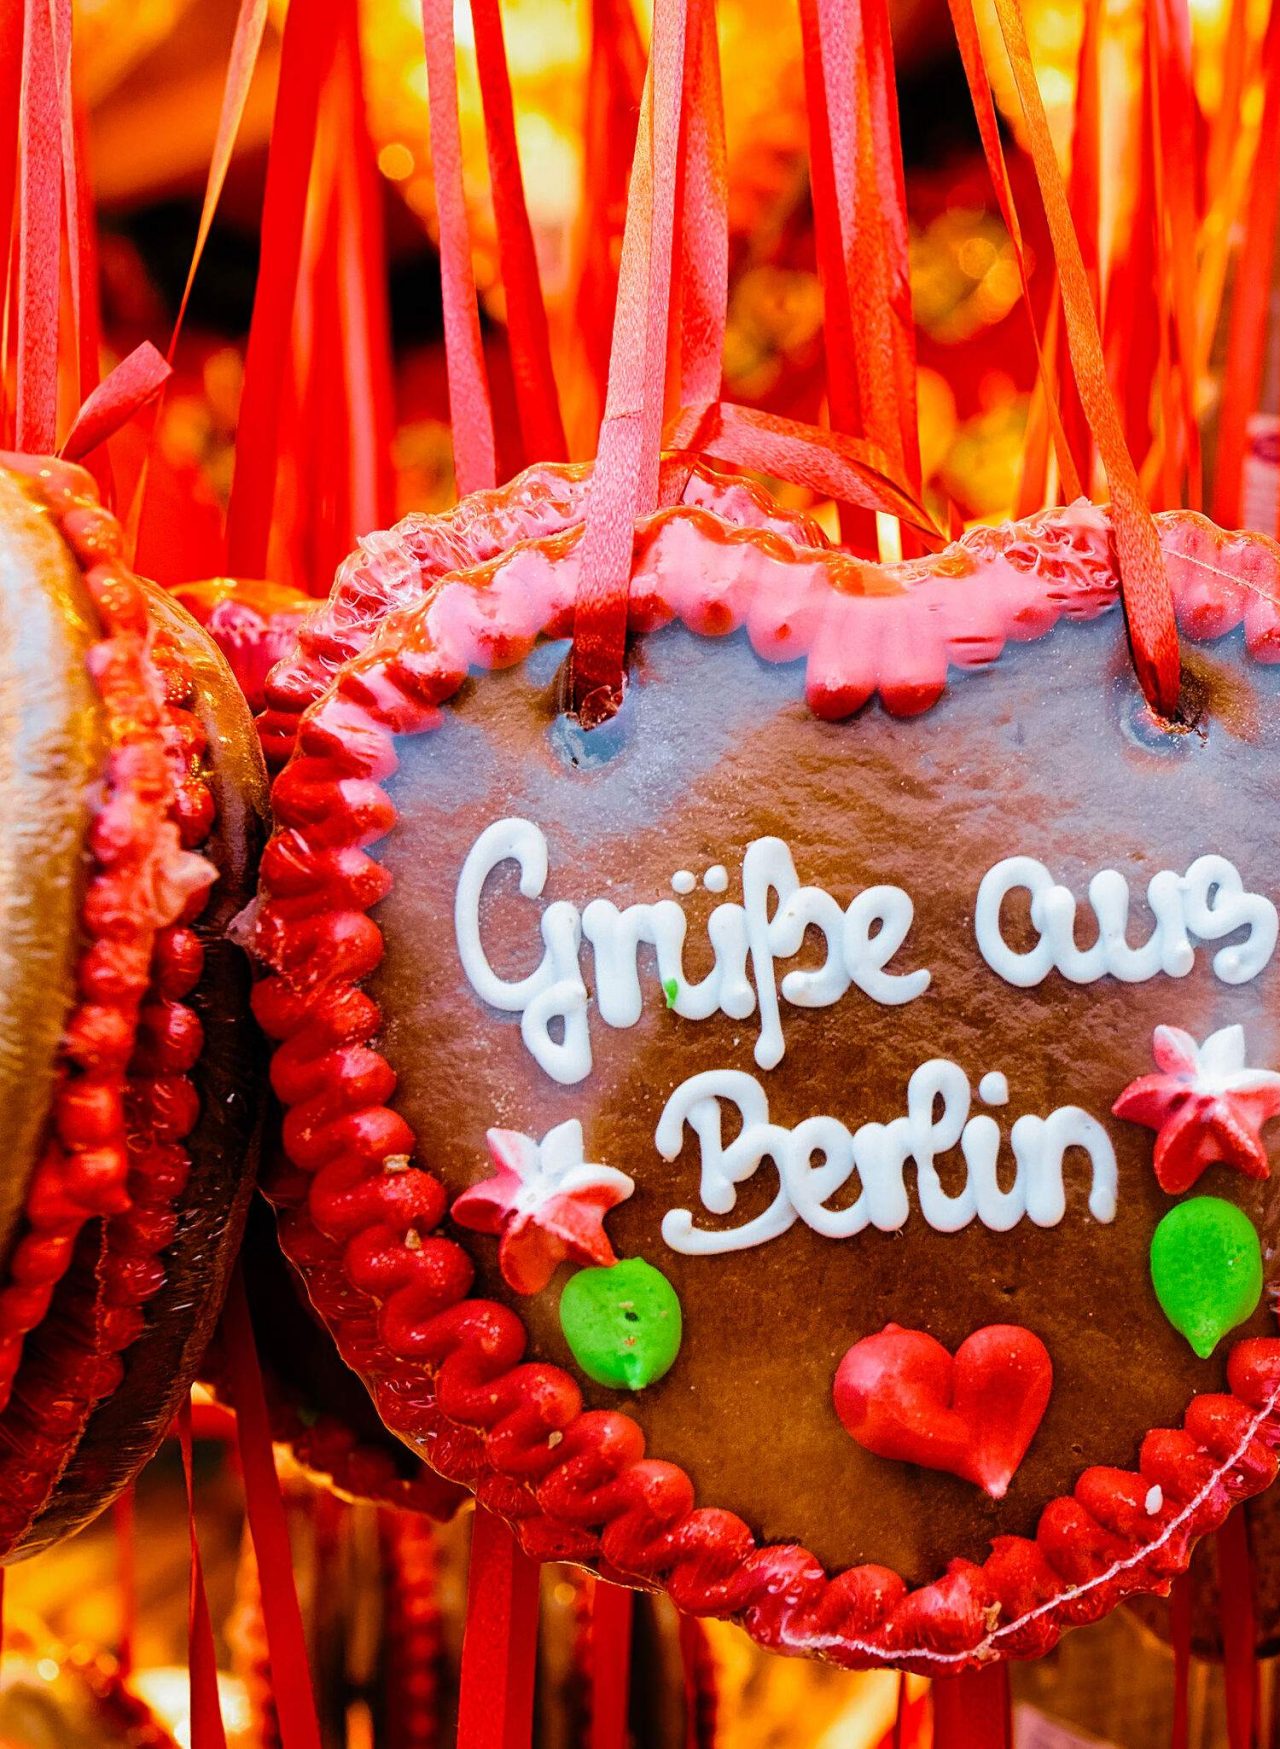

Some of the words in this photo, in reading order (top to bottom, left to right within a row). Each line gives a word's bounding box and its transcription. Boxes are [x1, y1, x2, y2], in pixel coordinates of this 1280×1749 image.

[455, 816, 932, 1084] Grüße
[975, 854, 1279, 987] aus
[655, 1059, 1117, 1255] Berlin
